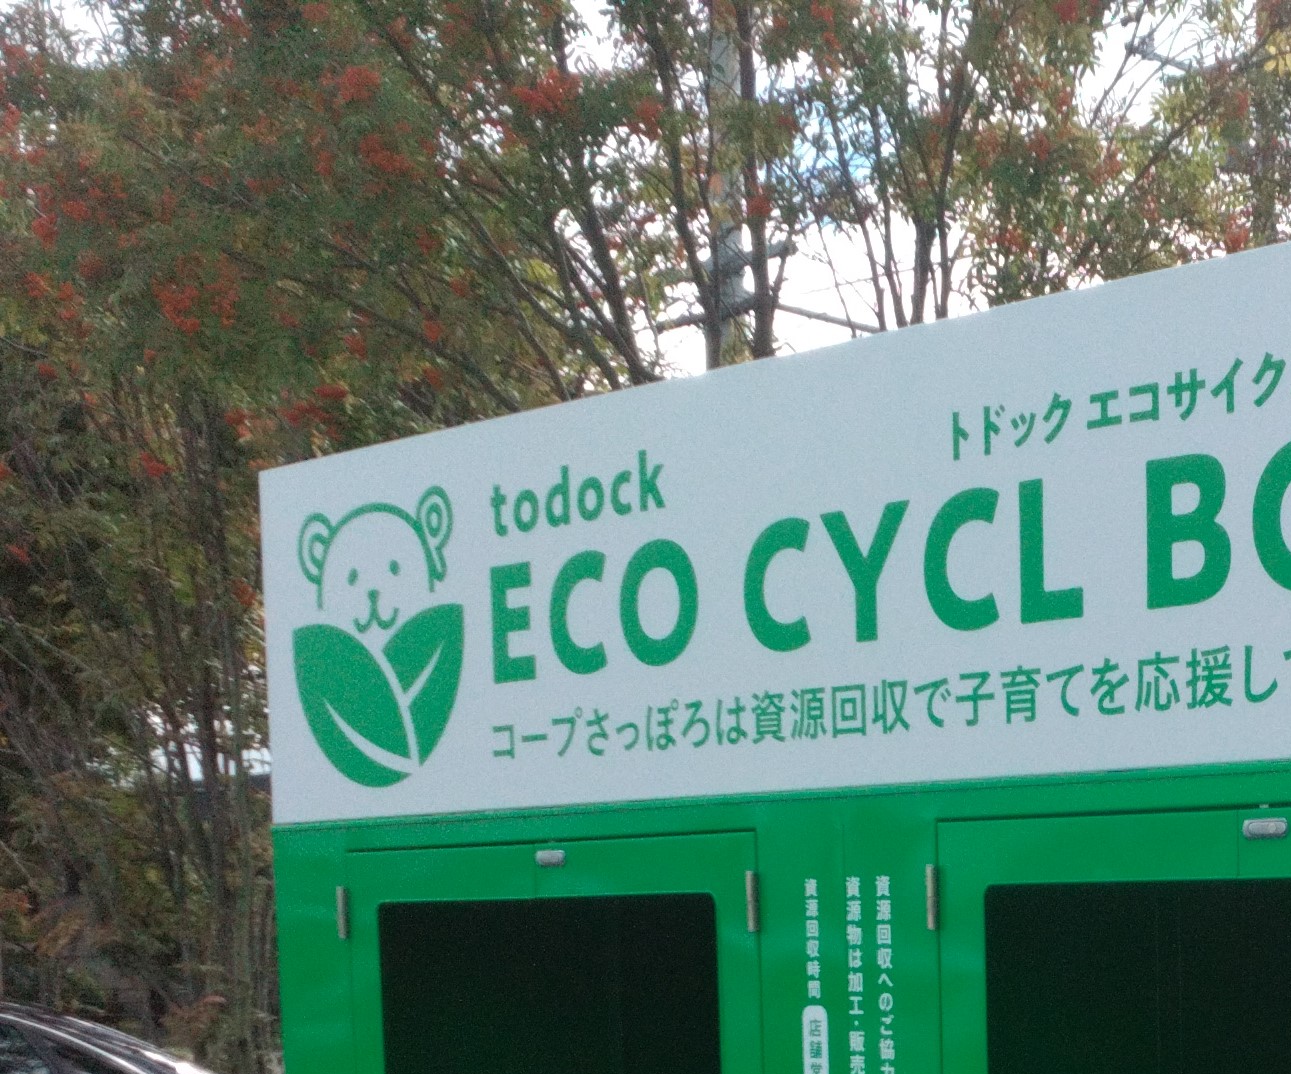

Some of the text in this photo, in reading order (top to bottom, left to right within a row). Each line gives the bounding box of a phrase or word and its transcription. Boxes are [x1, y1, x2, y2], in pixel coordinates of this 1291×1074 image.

[492, 449, 666, 537] todock
[489, 537, 700, 686] ECO
[742, 475, 1084, 652] CYCL
